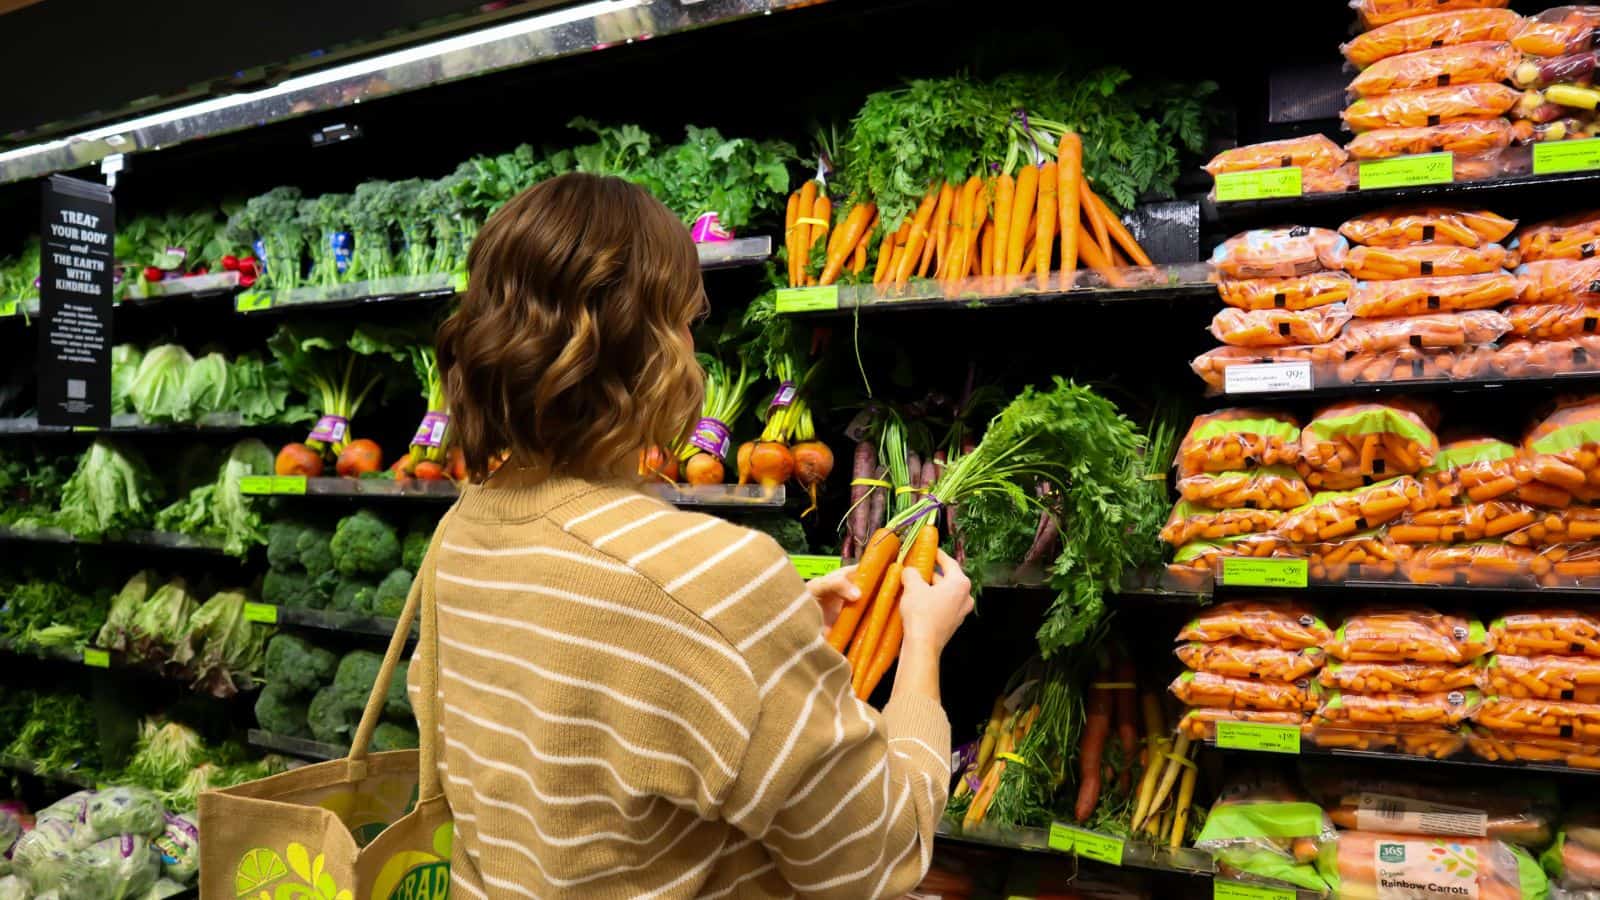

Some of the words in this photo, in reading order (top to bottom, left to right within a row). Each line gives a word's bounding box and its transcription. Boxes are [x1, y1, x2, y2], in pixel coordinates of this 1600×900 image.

[60, 210, 99, 229] TREAT
[51, 224, 78, 240] YOUR
[81, 230, 107, 245] BODY
[70, 244, 88, 254] and
[53, 253, 72, 266] THE
[73, 256, 105, 272] EARTH
[66, 267, 92, 281] WITH
[55, 279, 101, 295] KINDNESS
[1383, 846, 1403, 856] 365
[1381, 880, 1425, 890] Rainbow
[1428, 883, 1469, 895] Carrots
